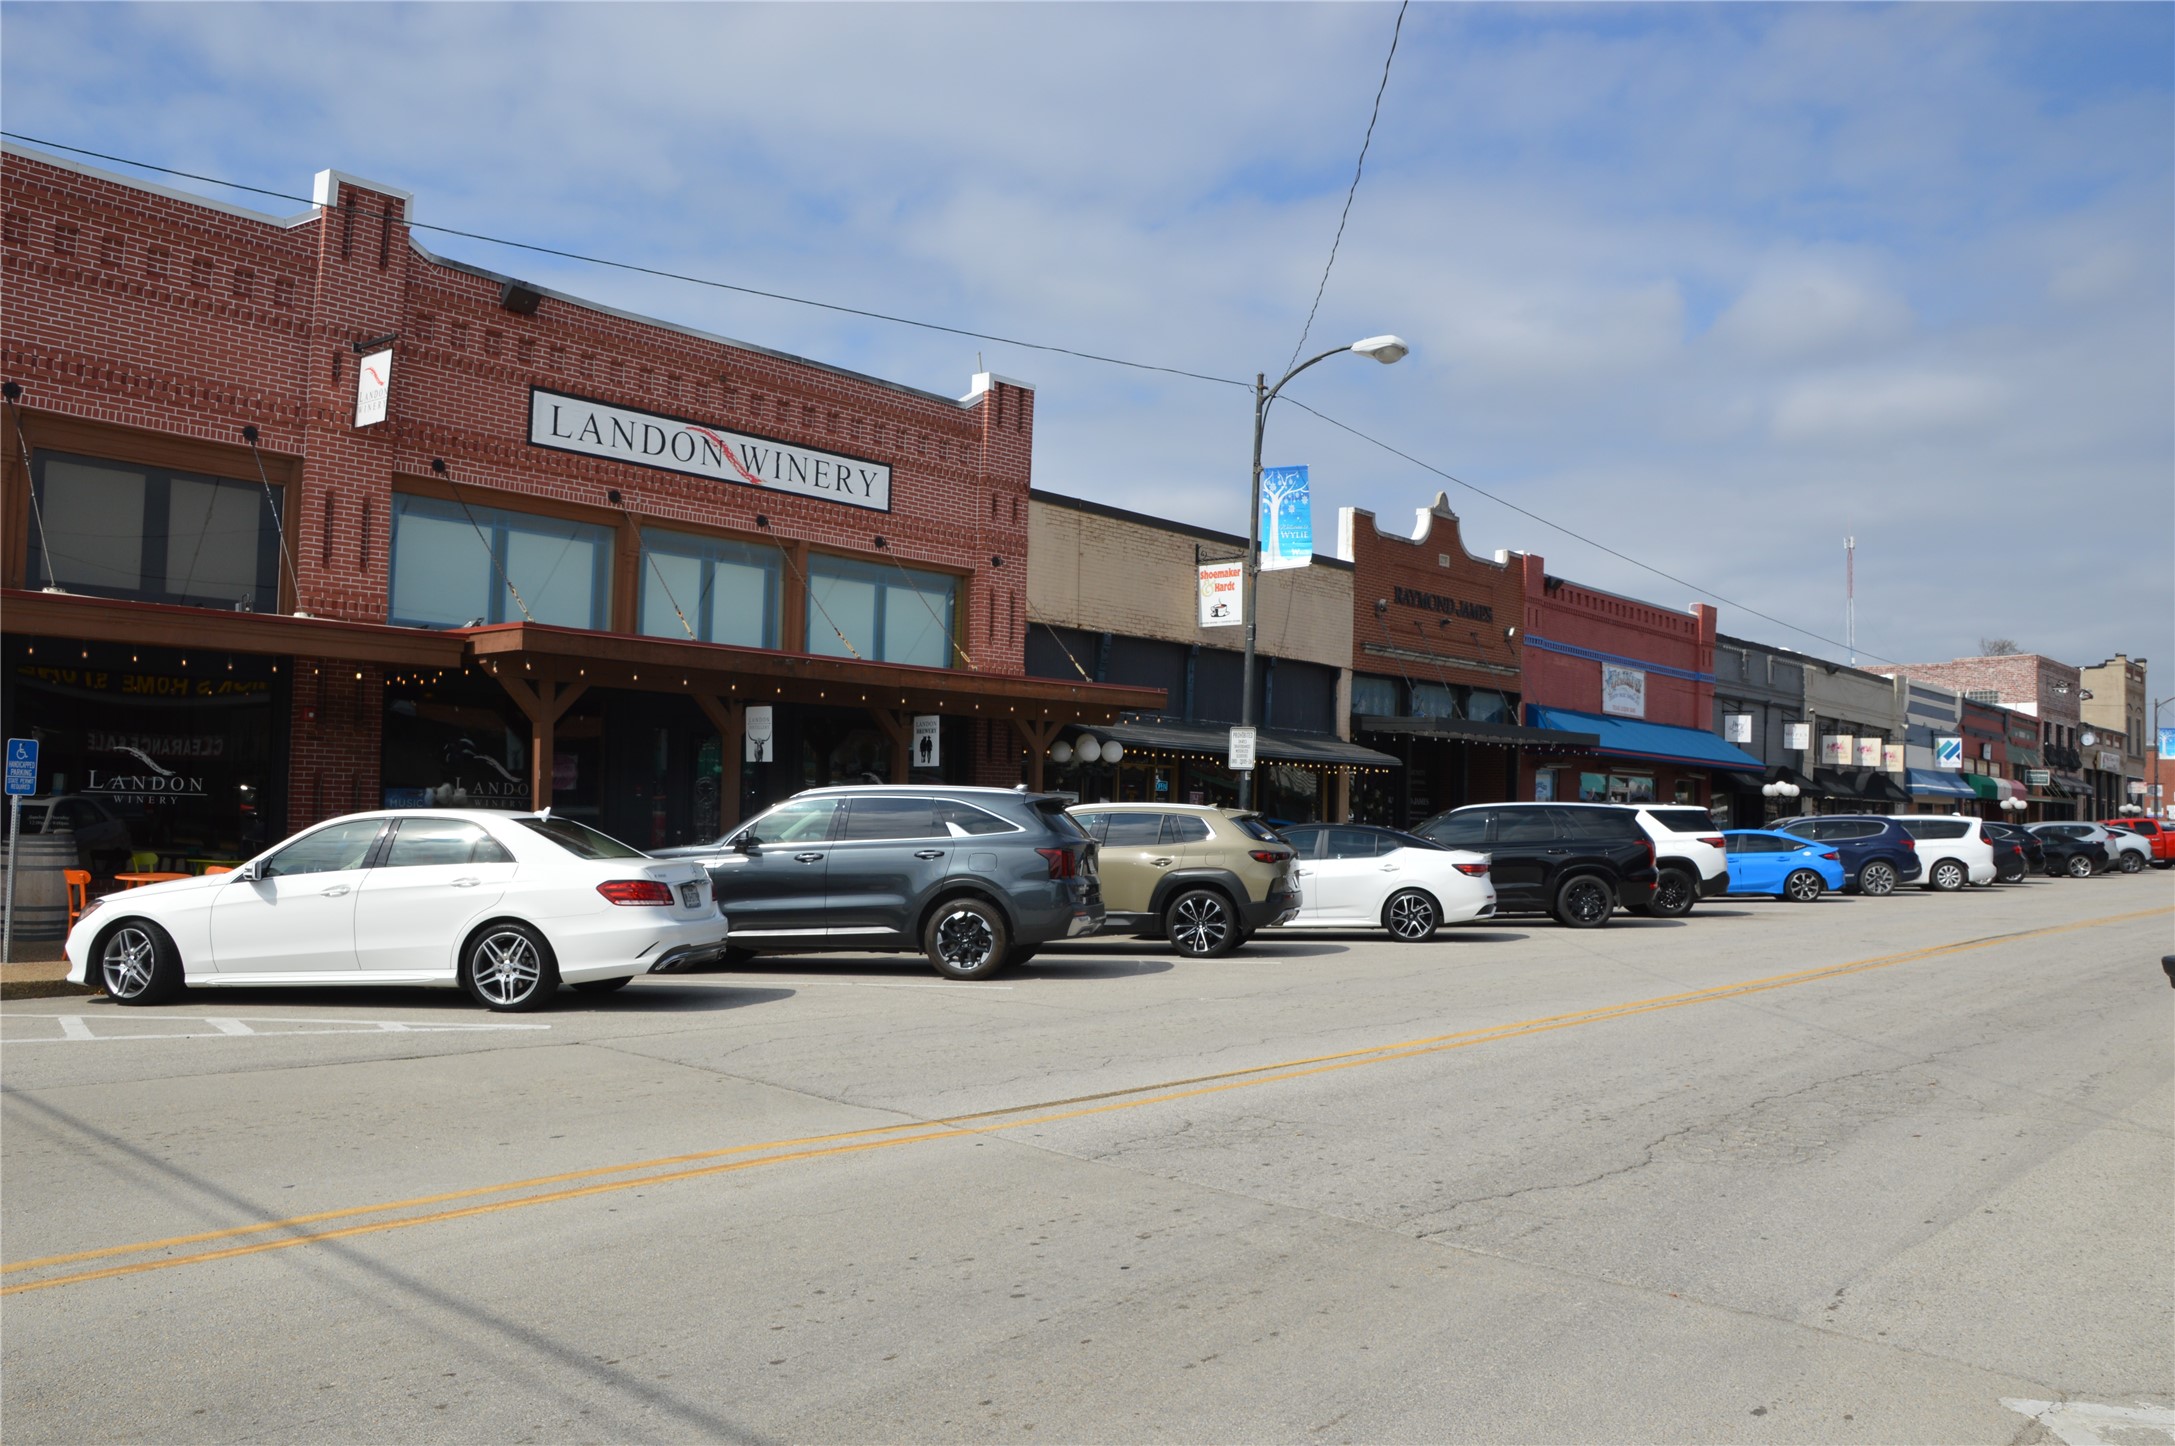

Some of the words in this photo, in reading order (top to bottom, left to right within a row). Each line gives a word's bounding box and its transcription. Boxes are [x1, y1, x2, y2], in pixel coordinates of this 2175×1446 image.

[550, 404, 723, 469] LANDON
[740, 443, 879, 498] WINERY
[1280, 531, 1309, 539] WYLIE
[1200, 567, 1241, 580] Shoemaker
[1214, 581, 1235, 592] Hardt
[1394, 585, 1456, 615] RAYMOND
[1456, 600, 1493, 624] JAMES
[8, 761, 35, 769] HANDICAPPED
[10, 768, 32, 777] PARKING
[88, 769, 204, 792] LANDON
[113, 795, 178, 805] WINERY
[389, 798, 424, 808] MUSIC
[474, 799, 524, 808] WINERY
